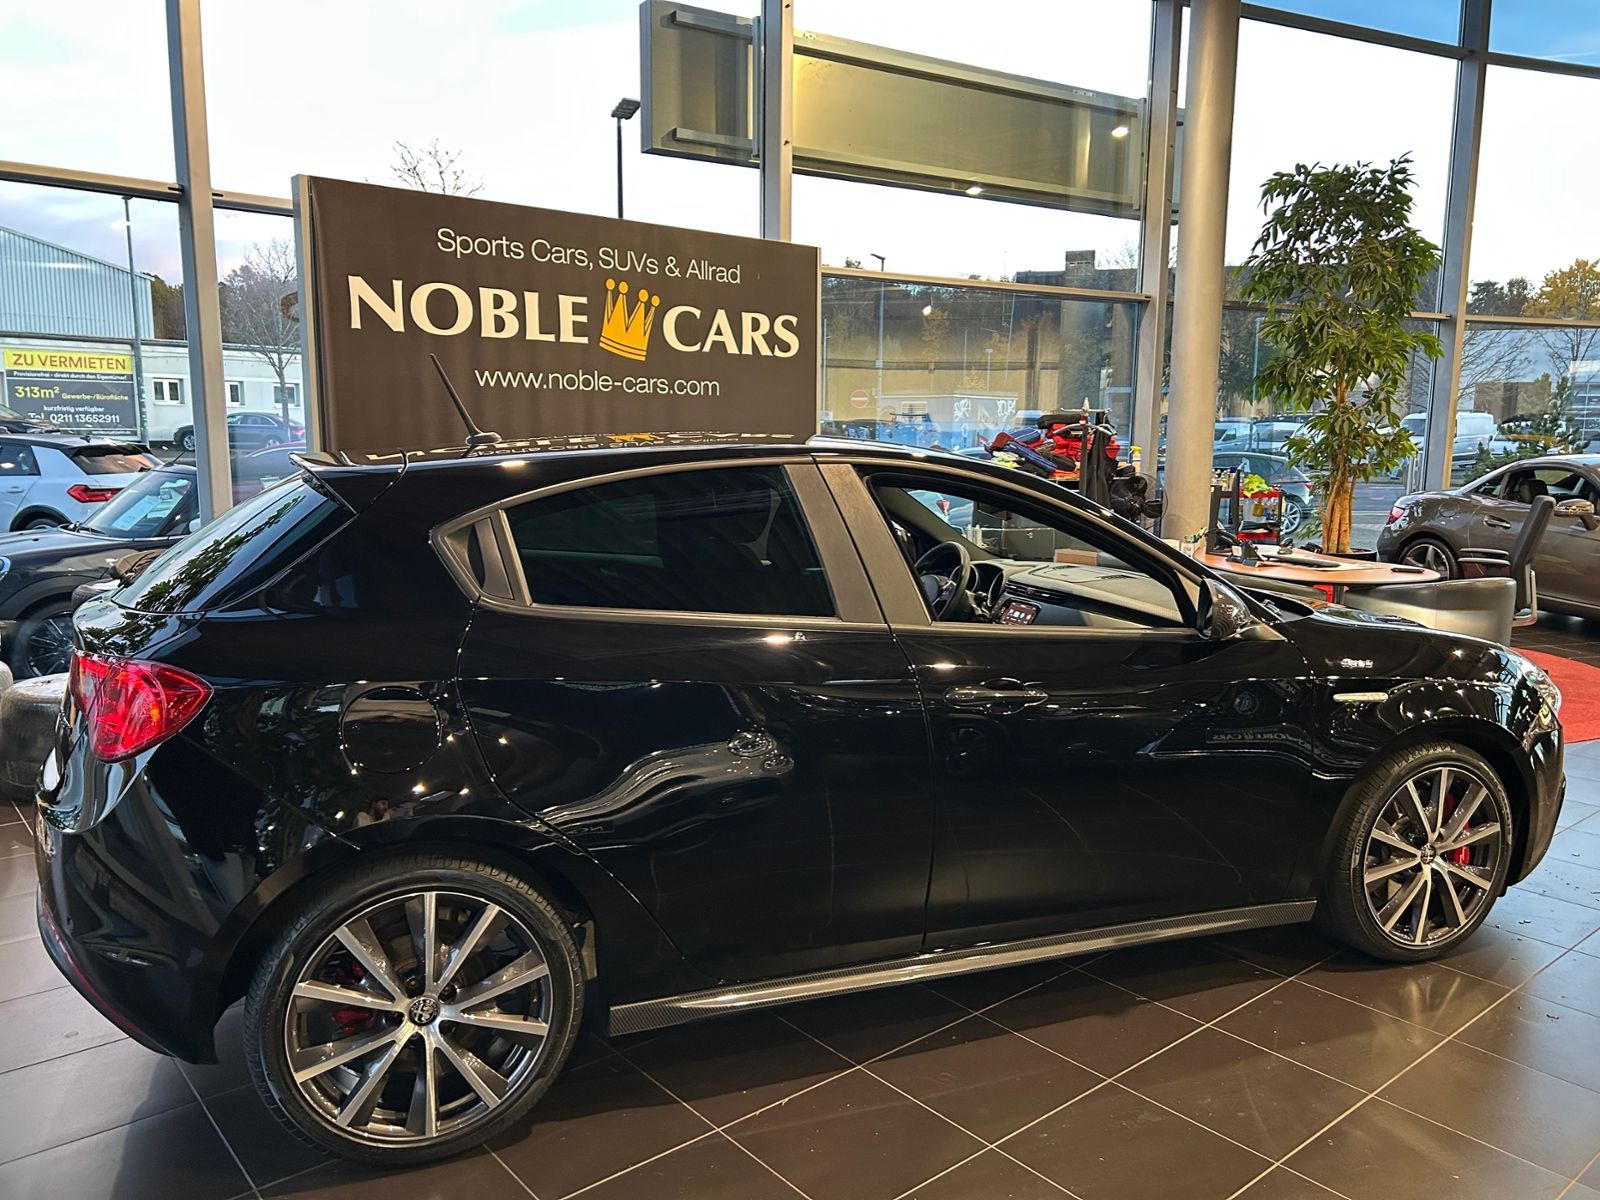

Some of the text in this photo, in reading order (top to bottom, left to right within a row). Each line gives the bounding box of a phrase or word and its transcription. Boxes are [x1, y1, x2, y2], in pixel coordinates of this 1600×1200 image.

[436, 227, 741, 284] Sports Cars, SUVs & Allrad
[347, 275, 800, 358] NOBLE CARS
[12, 354, 127, 370] ZU VERMIETEN
[475, 369, 720, 396] www.noble-cars.com
[49, 413, 73, 423] 0211
[76, 414, 120, 423] 13652911
